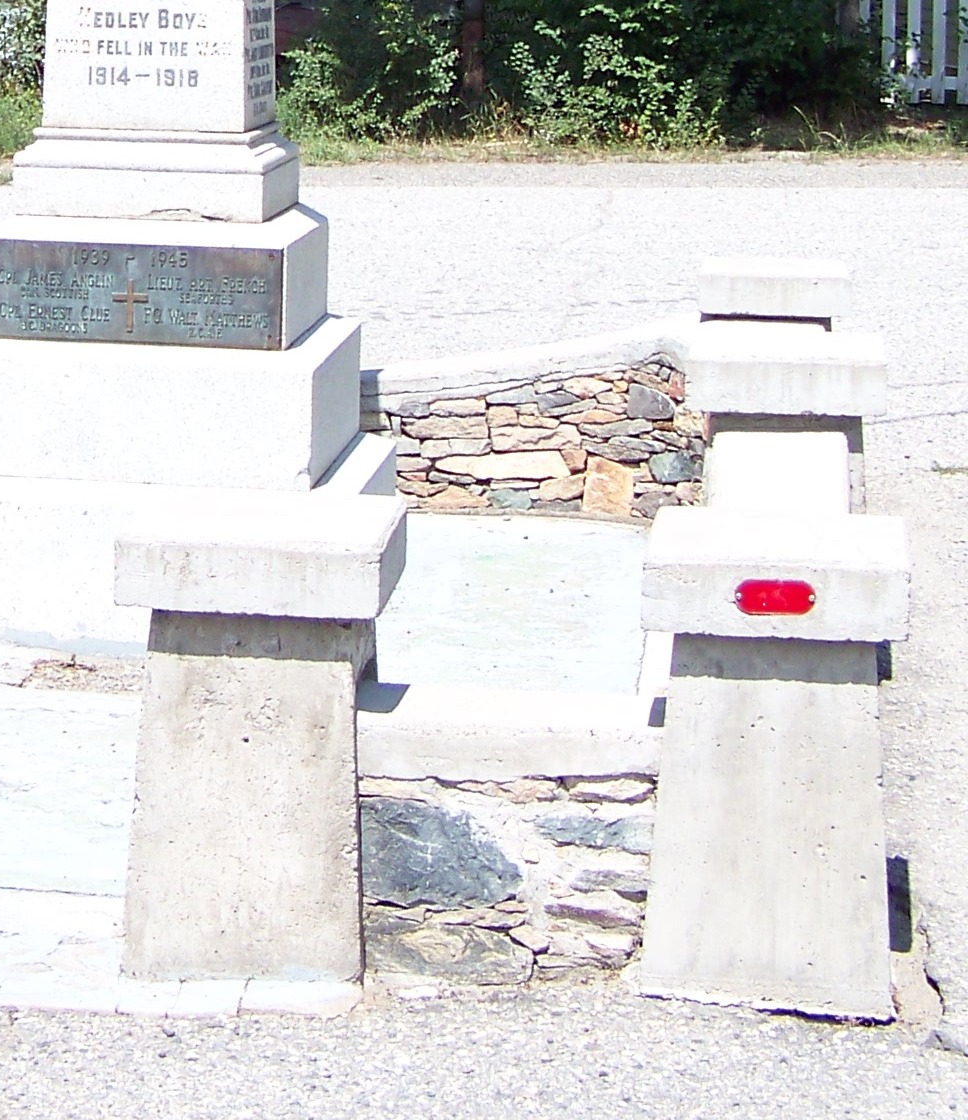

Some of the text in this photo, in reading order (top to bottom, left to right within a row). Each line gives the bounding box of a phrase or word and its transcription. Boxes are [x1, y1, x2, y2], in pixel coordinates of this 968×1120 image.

[97, 39, 132, 56] FELL
[138, 40, 153, 56] IN
[159, 41, 188, 57] THE
[73, 249, 110, 266] 1939
[150, 251, 188, 268] 1945
[24, 268, 63, 287] JAMES
[27, 303, 73, 320] ERNEST
[80, 305, 111, 322] CLUE
